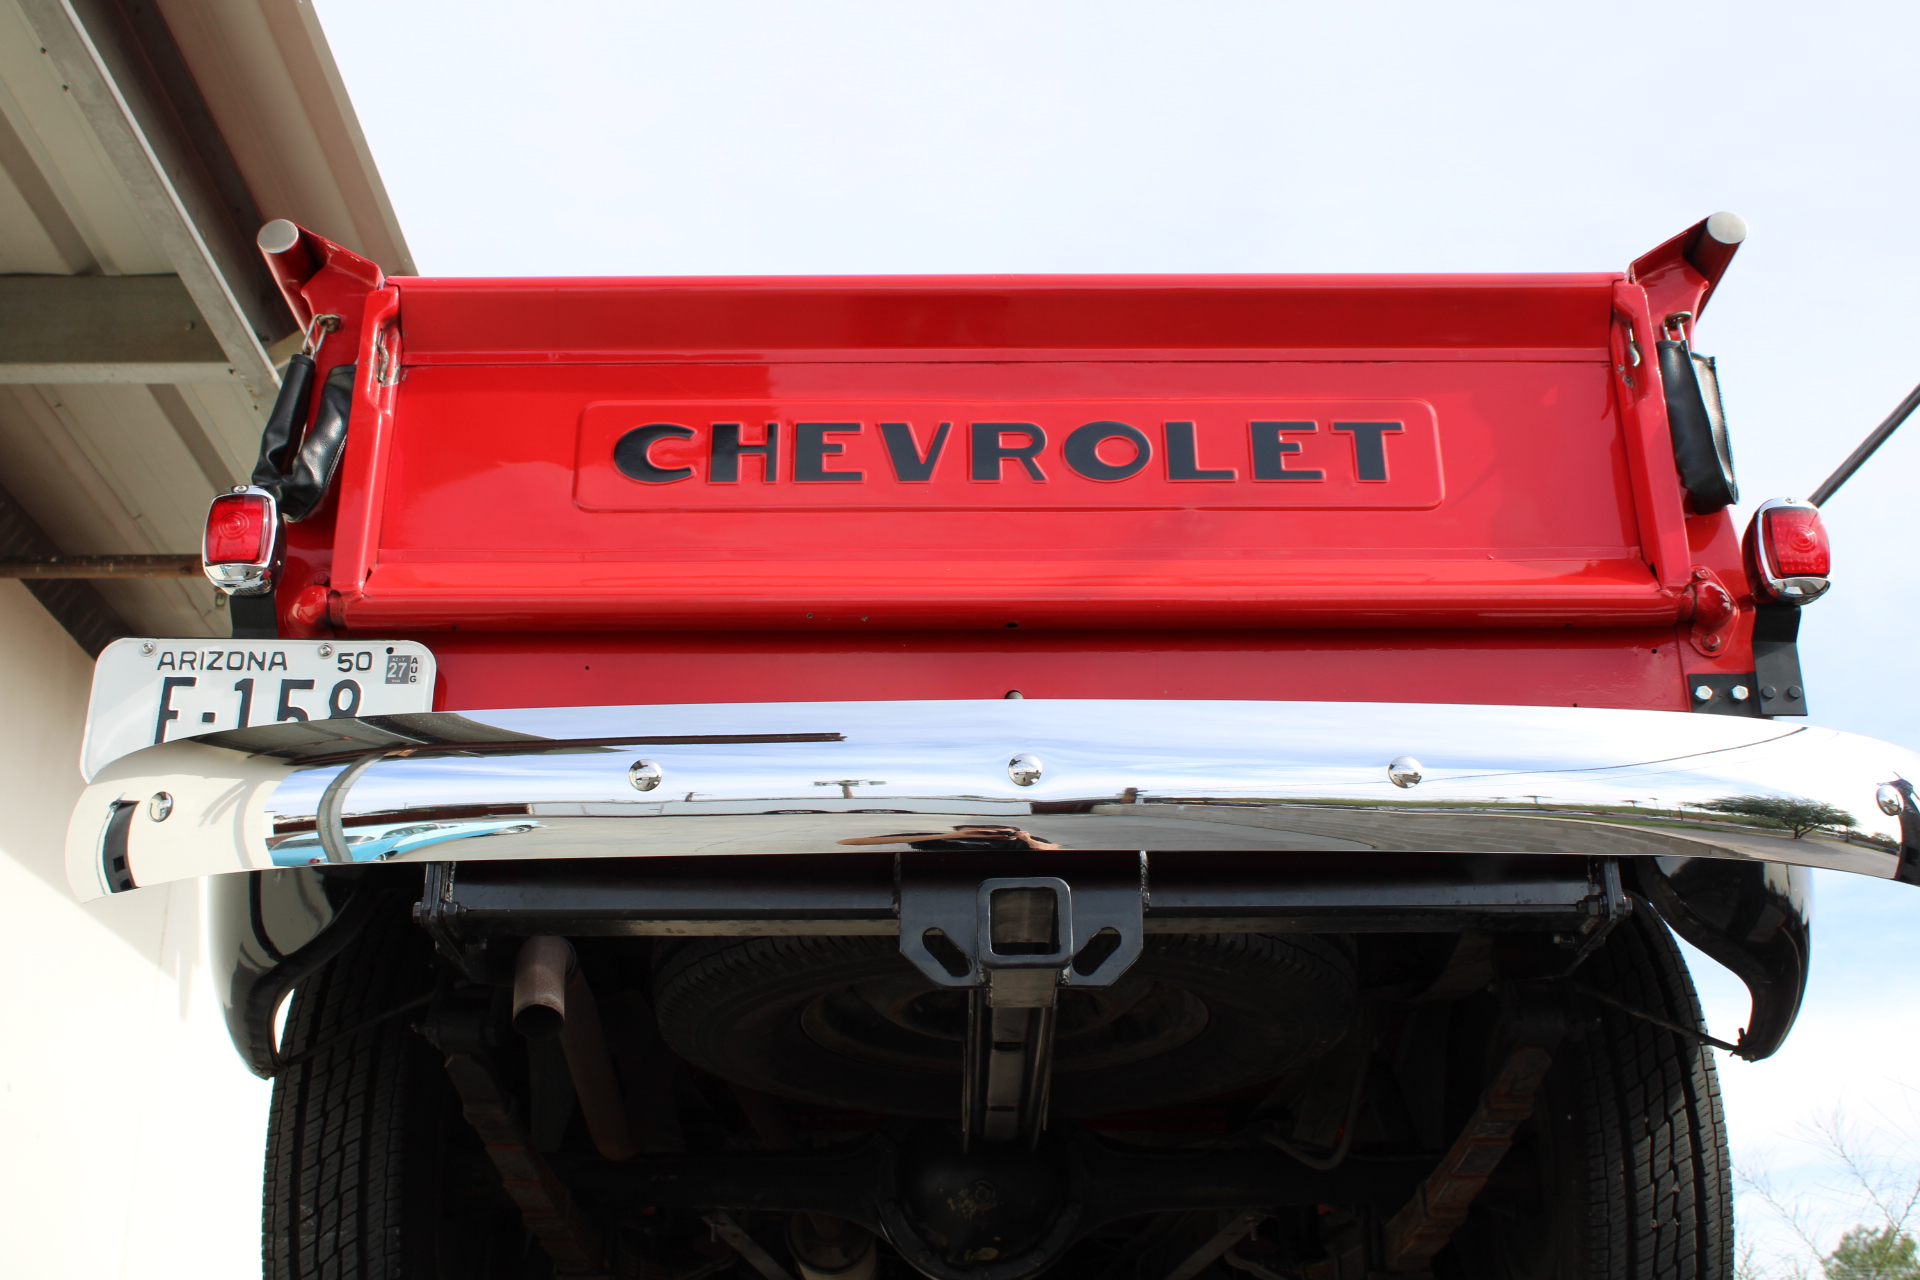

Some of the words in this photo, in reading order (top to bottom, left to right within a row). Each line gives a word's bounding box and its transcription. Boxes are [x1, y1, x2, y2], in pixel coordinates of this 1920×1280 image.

[612, 420, 1404, 484] CHEVROLET
[156, 651, 288, 671] ARIZONA
[337, 651, 373, 673] 50
[387, 662, 408, 678] 27
[409, 657, 419, 683] AUG
